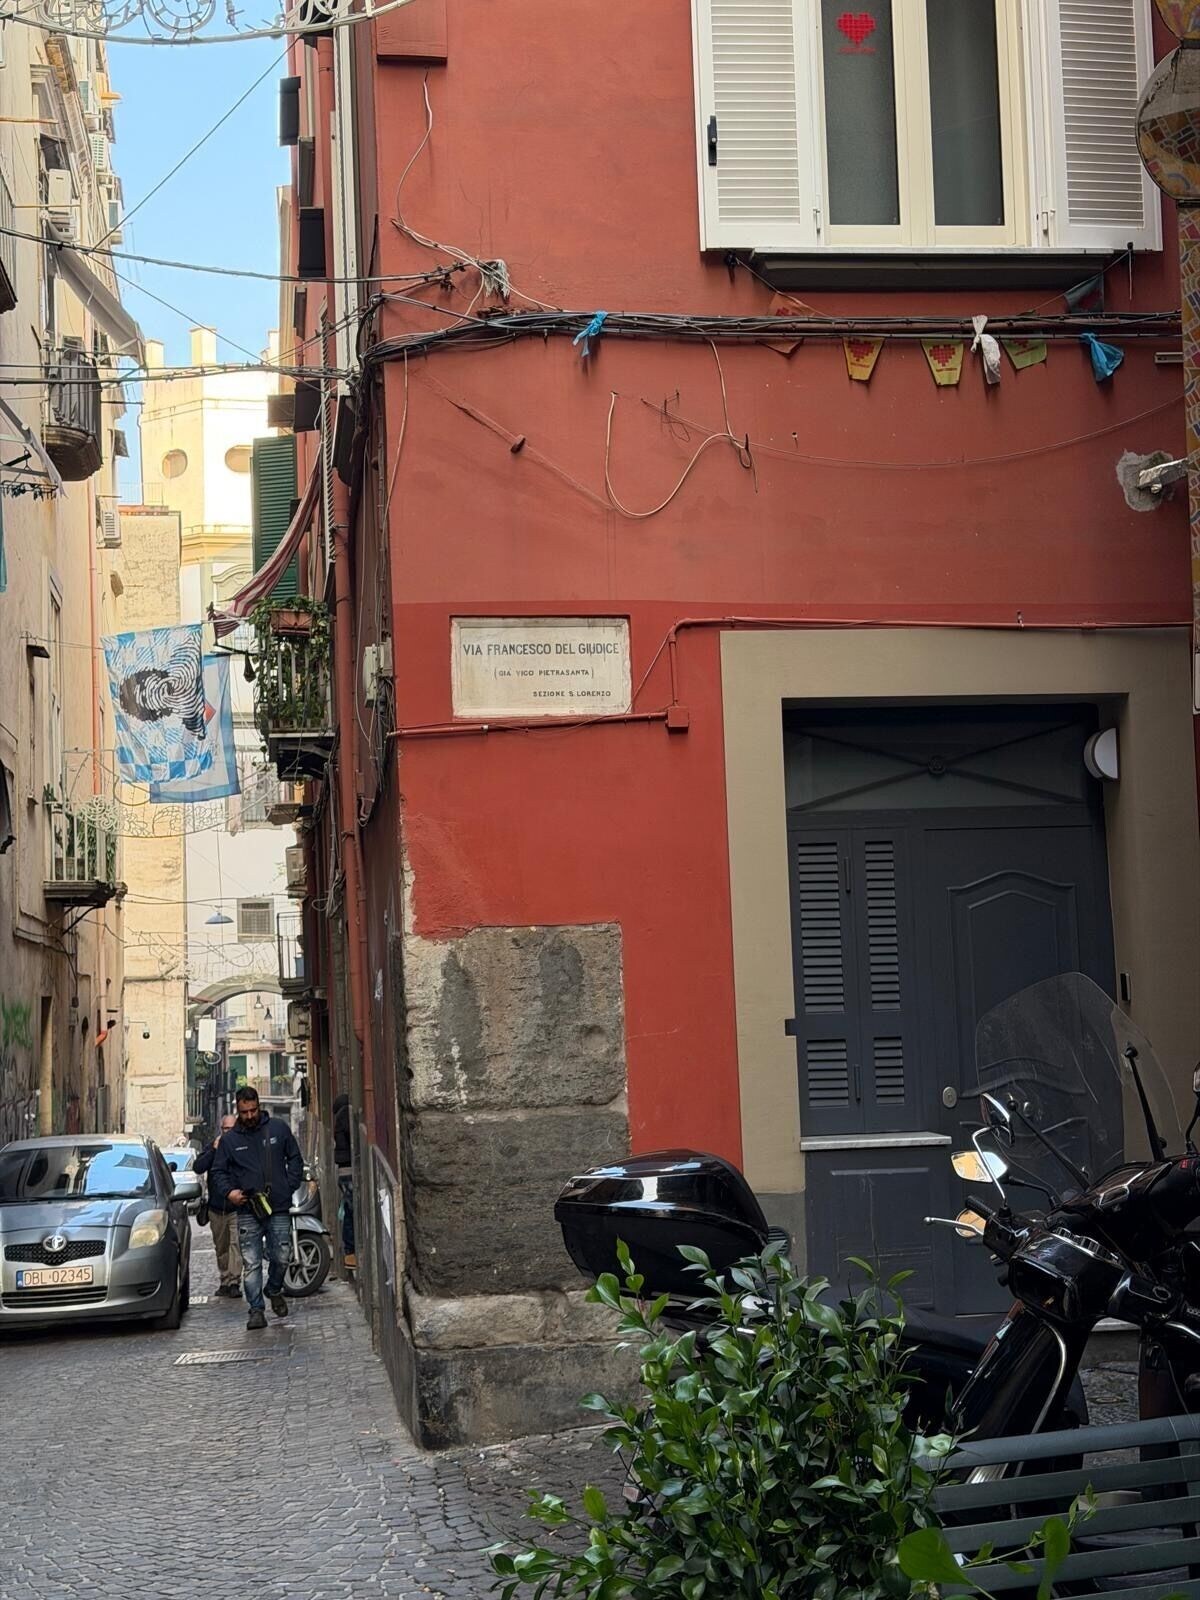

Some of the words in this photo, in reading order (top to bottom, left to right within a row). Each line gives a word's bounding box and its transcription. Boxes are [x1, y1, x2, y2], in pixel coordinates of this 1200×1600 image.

[463, 643, 483, 656] VIA
[487, 643, 552, 656] FRANCESCO
[555, 643, 576, 655] DEL
[578, 642, 619, 655] GIUDICE
[515, 669, 534, 677] VICO
[533, 690, 565, 698] SEZIONE
[576, 690, 611, 698] LORENZO
[52, 1267, 91, 1283] 02345
